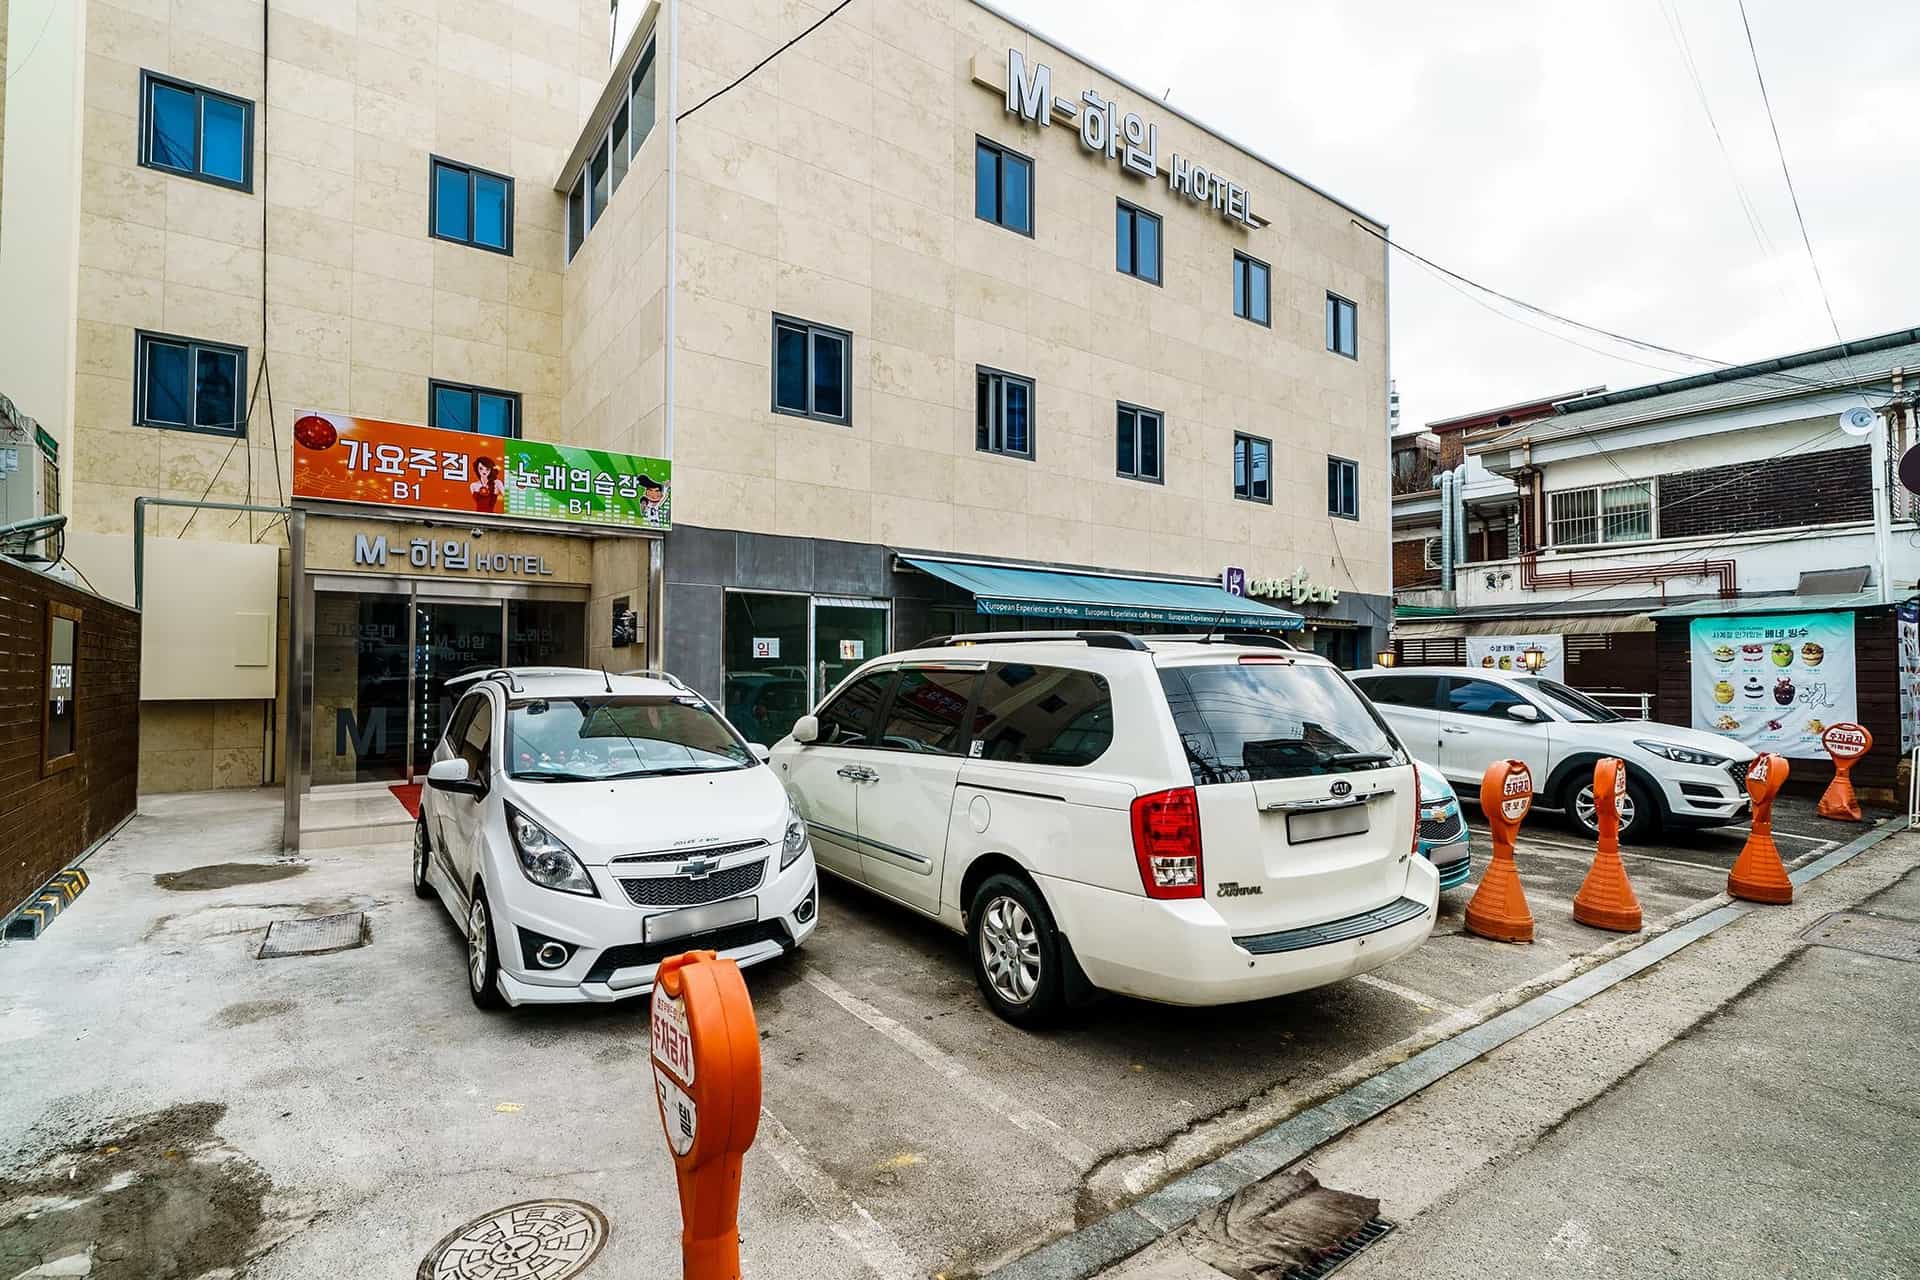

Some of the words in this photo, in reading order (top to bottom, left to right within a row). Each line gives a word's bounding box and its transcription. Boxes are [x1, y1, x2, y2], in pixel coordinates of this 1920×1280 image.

[1007, 48, 1158, 178] M-하임
[1169, 153, 1260, 230] HOTEL
[340, 439, 469, 482] 가요주점
[516, 461, 640, 498] 노래연습장
[393, 481, 420, 500] B1
[569, 498, 592, 515] B1
[355, 533, 470, 570] M-하임
[476, 552, 552, 575] HOTEL
[986, 601, 1015, 612] European
[1016, 603, 1048, 614] Experience
[1085, 607, 1110, 616] European
[1765, 629, 1784, 638] 베네
[1788, 628, 1808, 638] 빙수
